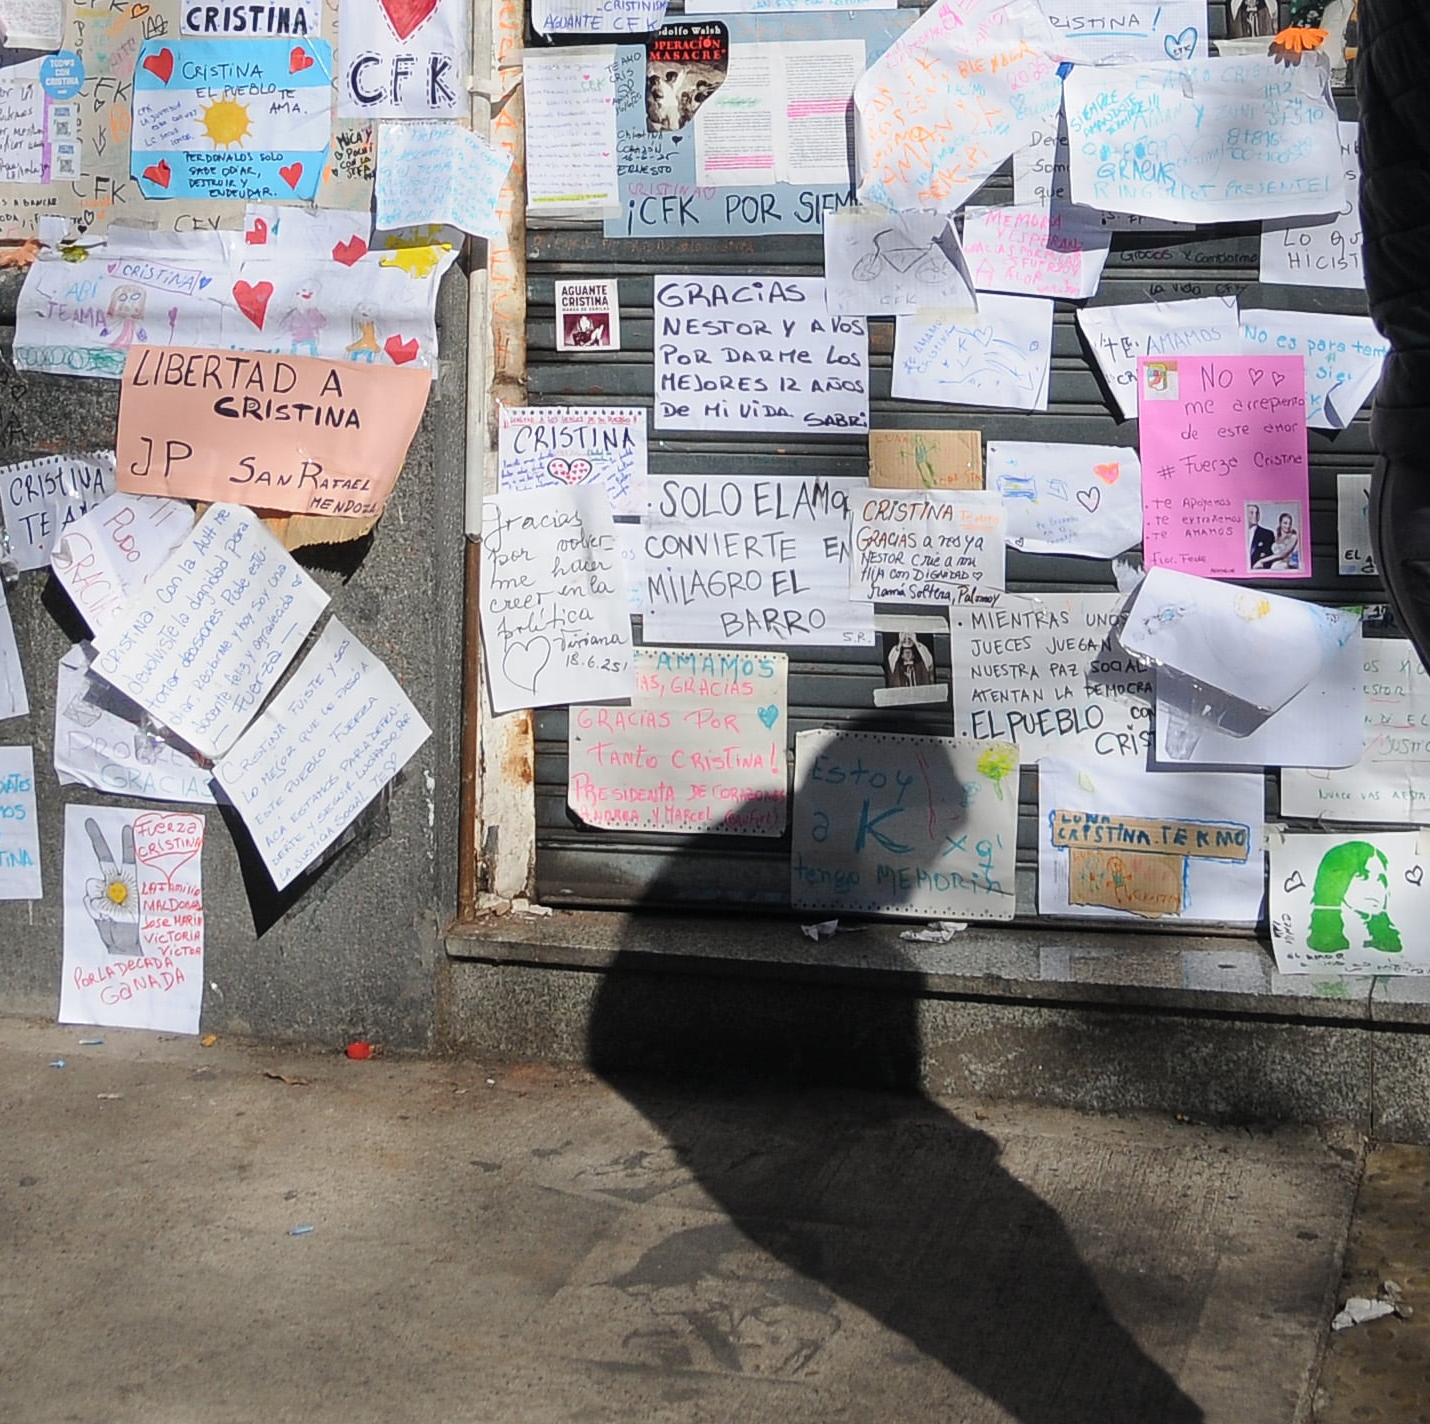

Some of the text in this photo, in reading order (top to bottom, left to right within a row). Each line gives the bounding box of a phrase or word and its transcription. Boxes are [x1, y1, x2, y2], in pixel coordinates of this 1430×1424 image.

[186, 5, 308, 34] CRISTINA
[690, 25, 722, 36] Walsh
[347, 51, 458, 109] CFK
[561, 284, 608, 298] AGUANTE
[561, 296, 609, 307] CRISTINA
[663, 316, 864, 337] NESTOR Y A VOS
[132, 349, 343, 398] LIBERTAD A
[778, 376, 800, 392] 12
[811, 371, 864, 394] AÑOS
[214, 395, 361, 430] CRISTINA
[229, 455, 371, 492] SAN RAFAEL
